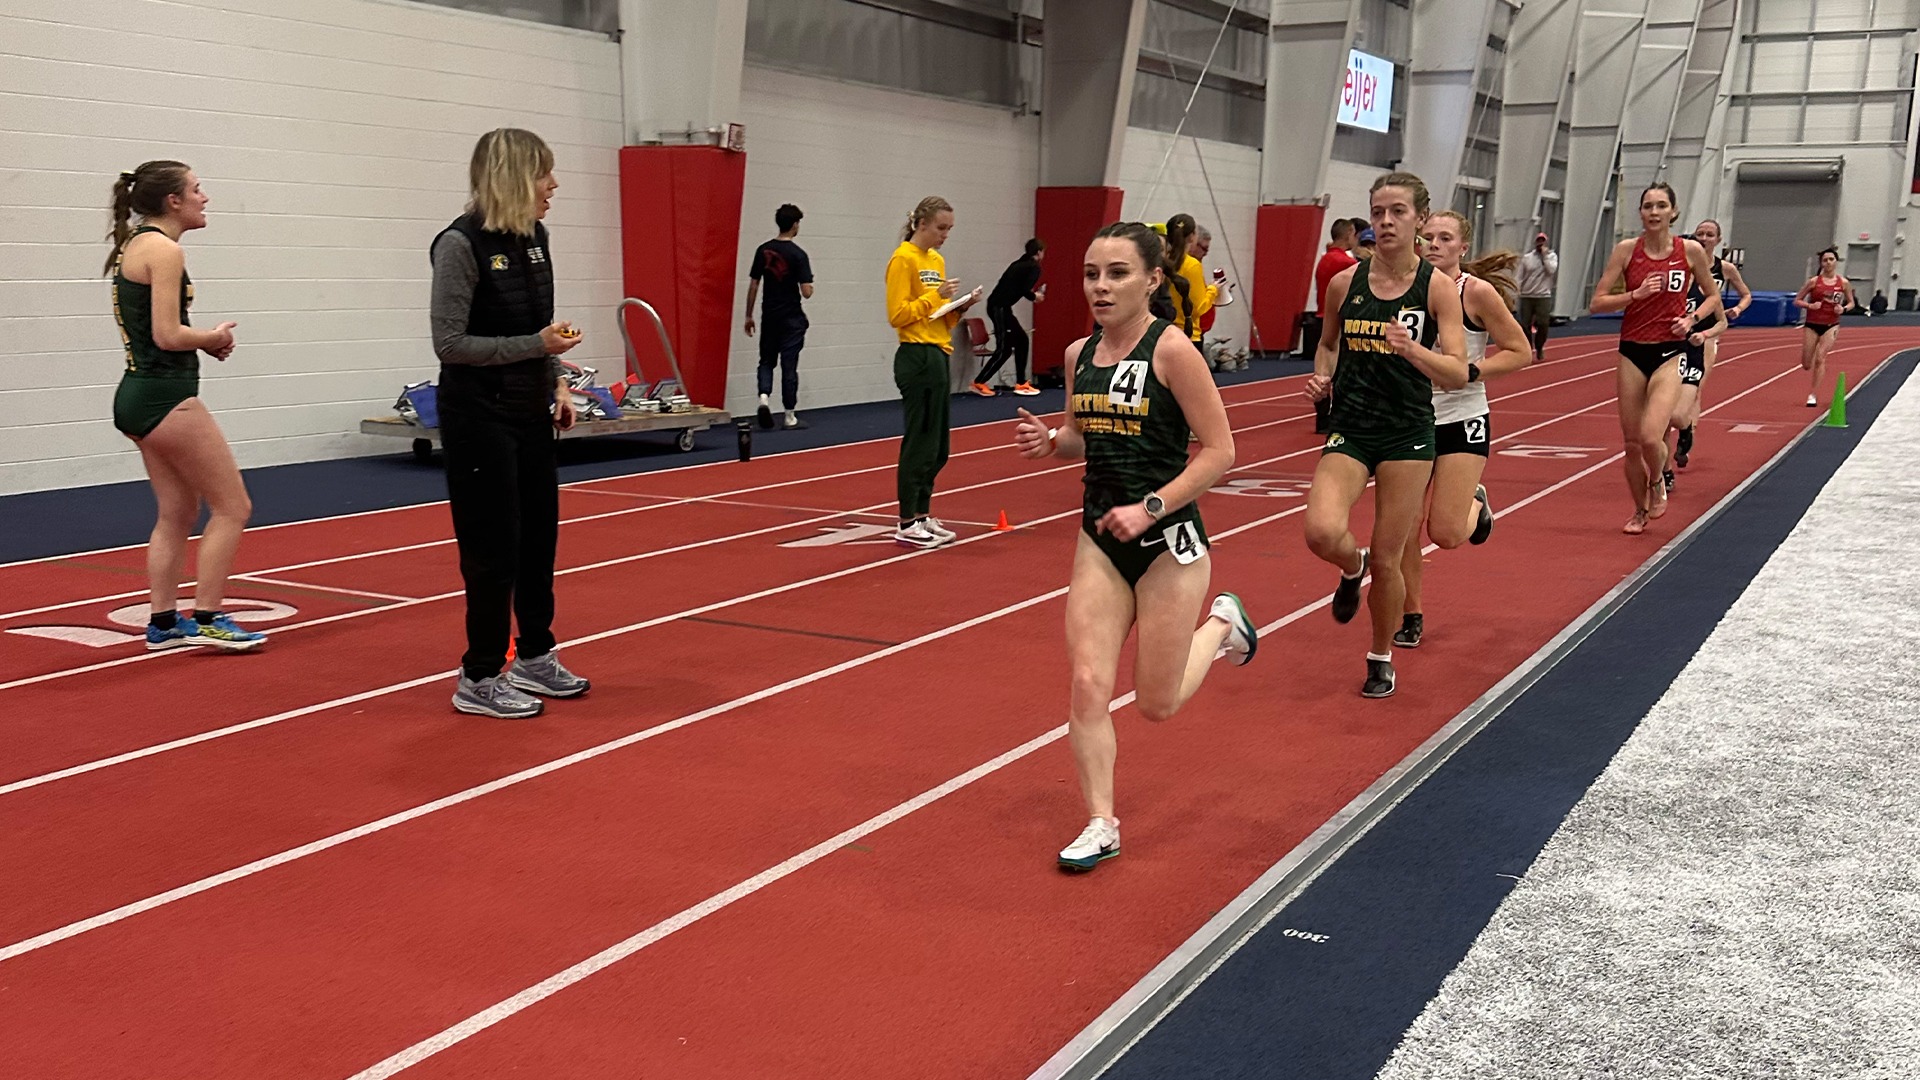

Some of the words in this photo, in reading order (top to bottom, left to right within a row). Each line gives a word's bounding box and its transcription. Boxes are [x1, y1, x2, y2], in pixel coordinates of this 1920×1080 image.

[1344, 57, 1378, 121] eijer
[1670, 272, 1682, 290] 5
[1401, 313, 1420, 343] 3
[1112, 363, 1139, 402] 4
[1072, 394, 1149, 416] RTHERN
[1467, 419, 1483, 441] 2
[1175, 522, 1198, 557] 4
